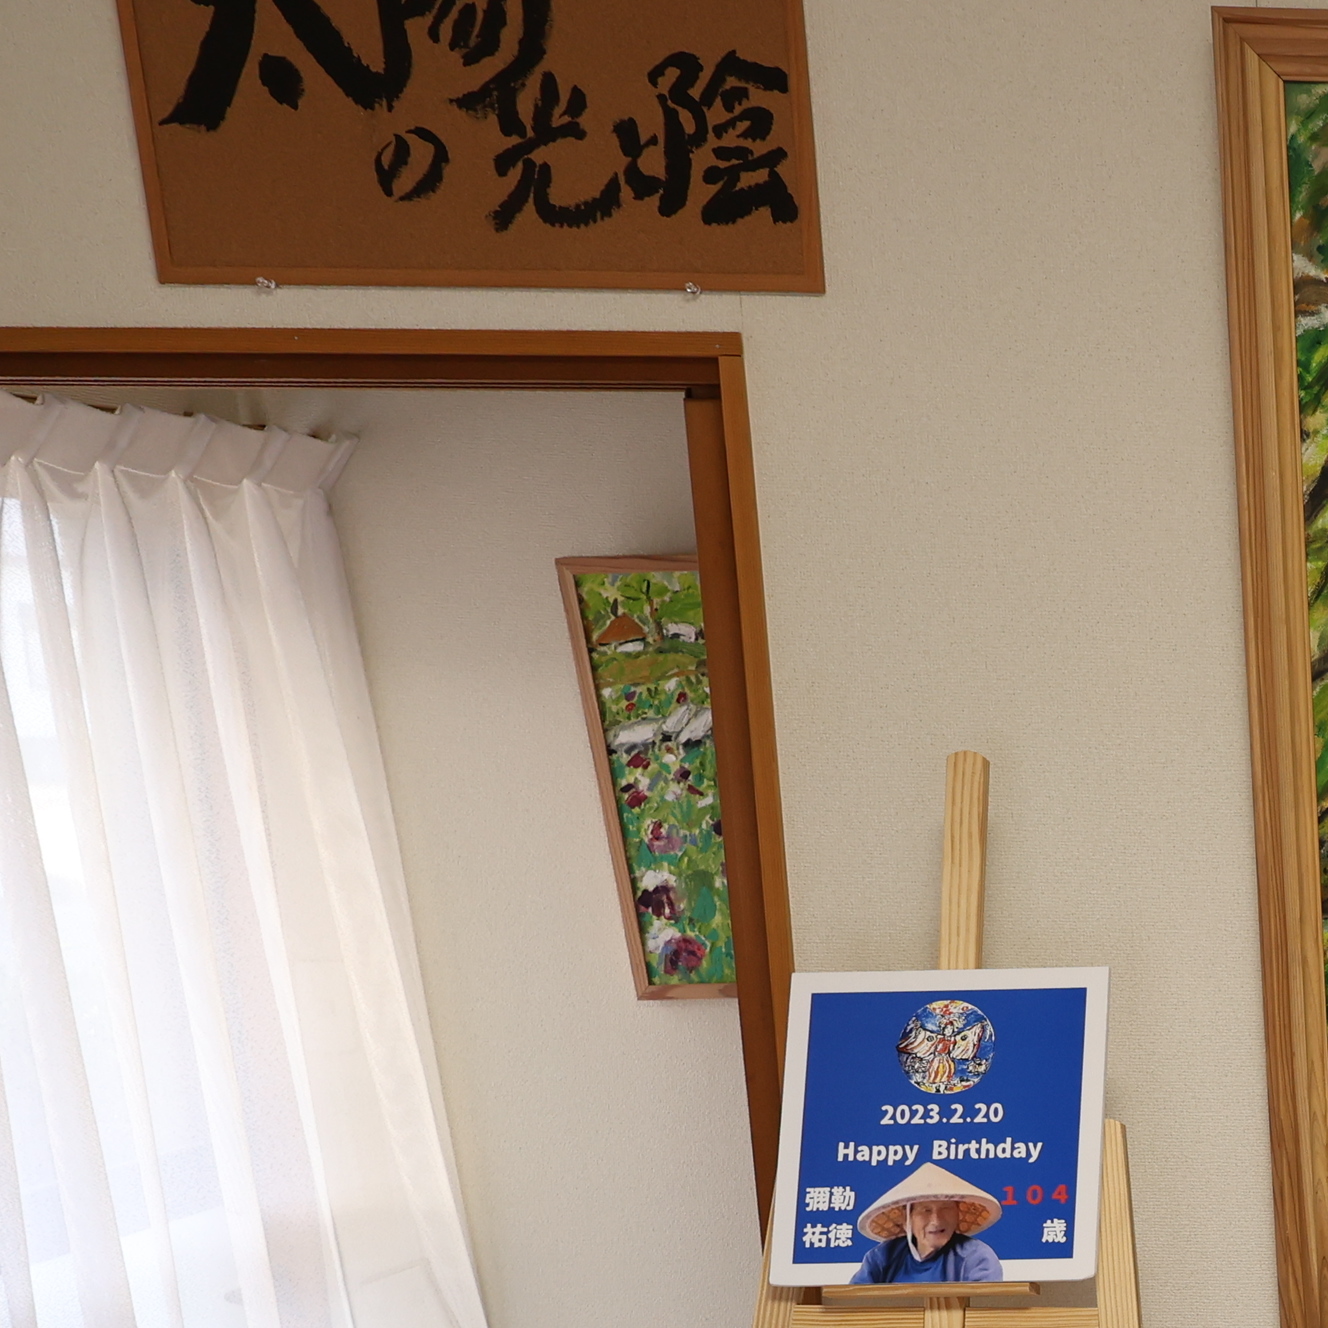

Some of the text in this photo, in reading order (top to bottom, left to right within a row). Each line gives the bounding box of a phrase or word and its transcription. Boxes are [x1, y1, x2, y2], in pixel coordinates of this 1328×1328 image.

[879, 1102, 1004, 1125] 2023.2.20
[837, 1137, 1043, 1166] Happy Birthday
[1041, 1218, 1067, 1244] 歳
